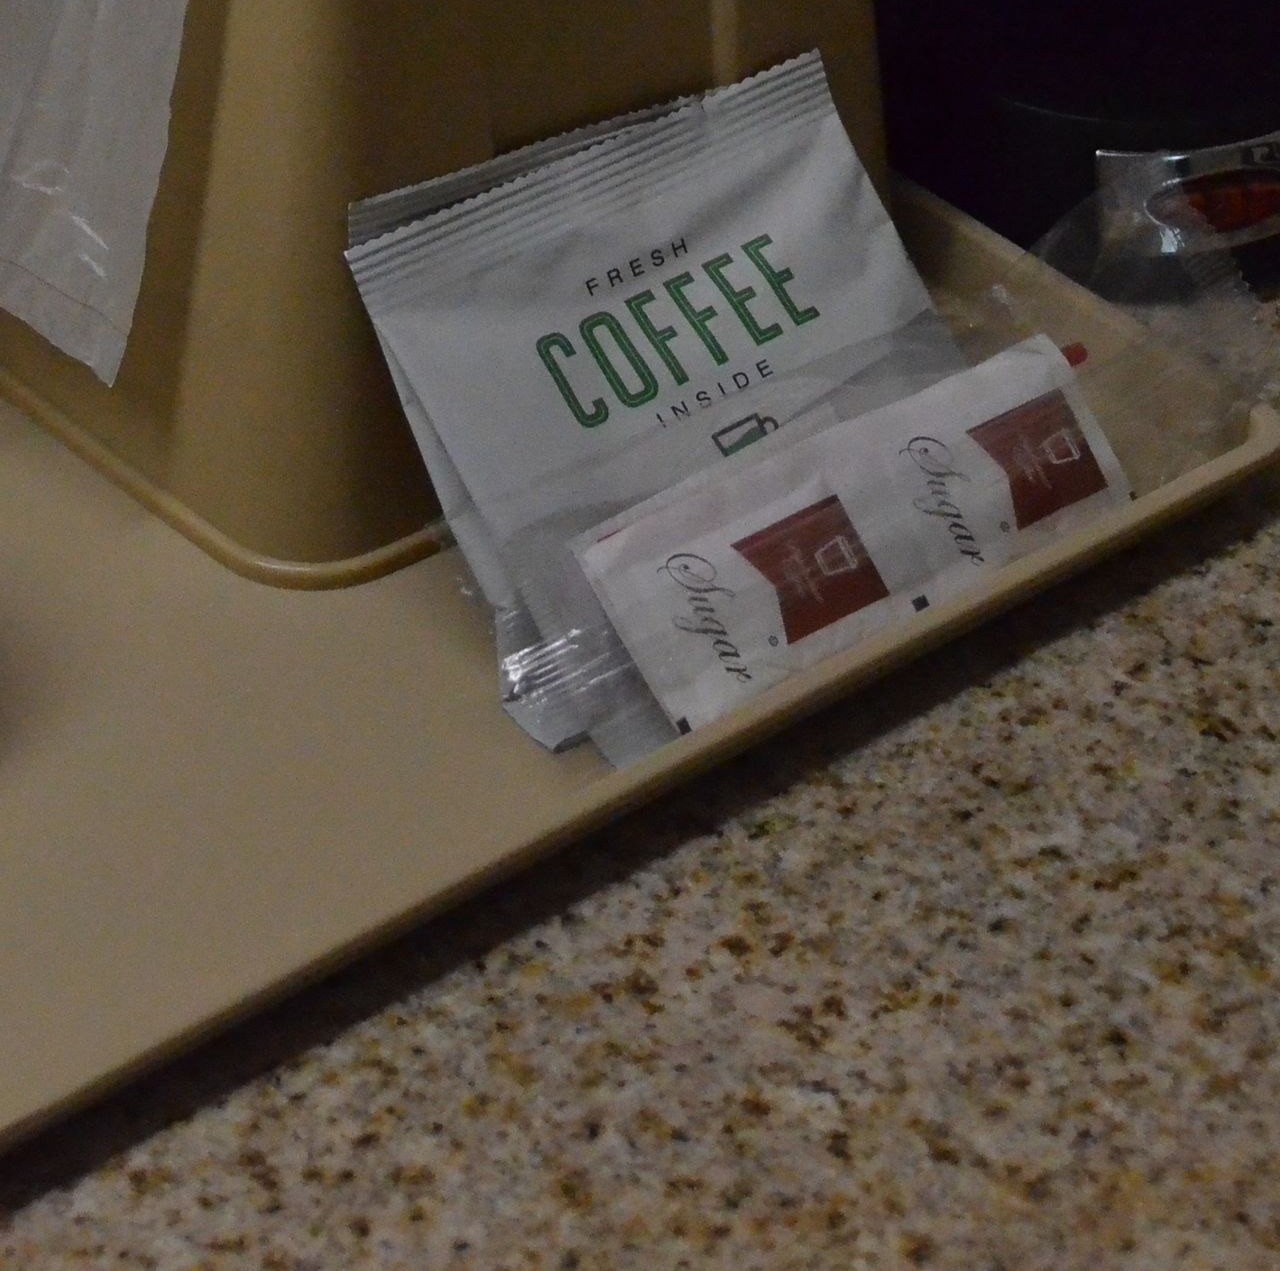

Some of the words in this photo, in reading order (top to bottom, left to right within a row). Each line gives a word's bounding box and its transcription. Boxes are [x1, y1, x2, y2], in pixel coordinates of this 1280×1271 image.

[535, 233, 820, 429] COFFEE
[585, 238, 689, 297] FRESH
[656, 359, 774, 428] INSIDE
[898, 435, 985, 567] Sugar
[656, 553, 753, 684] Sugar
